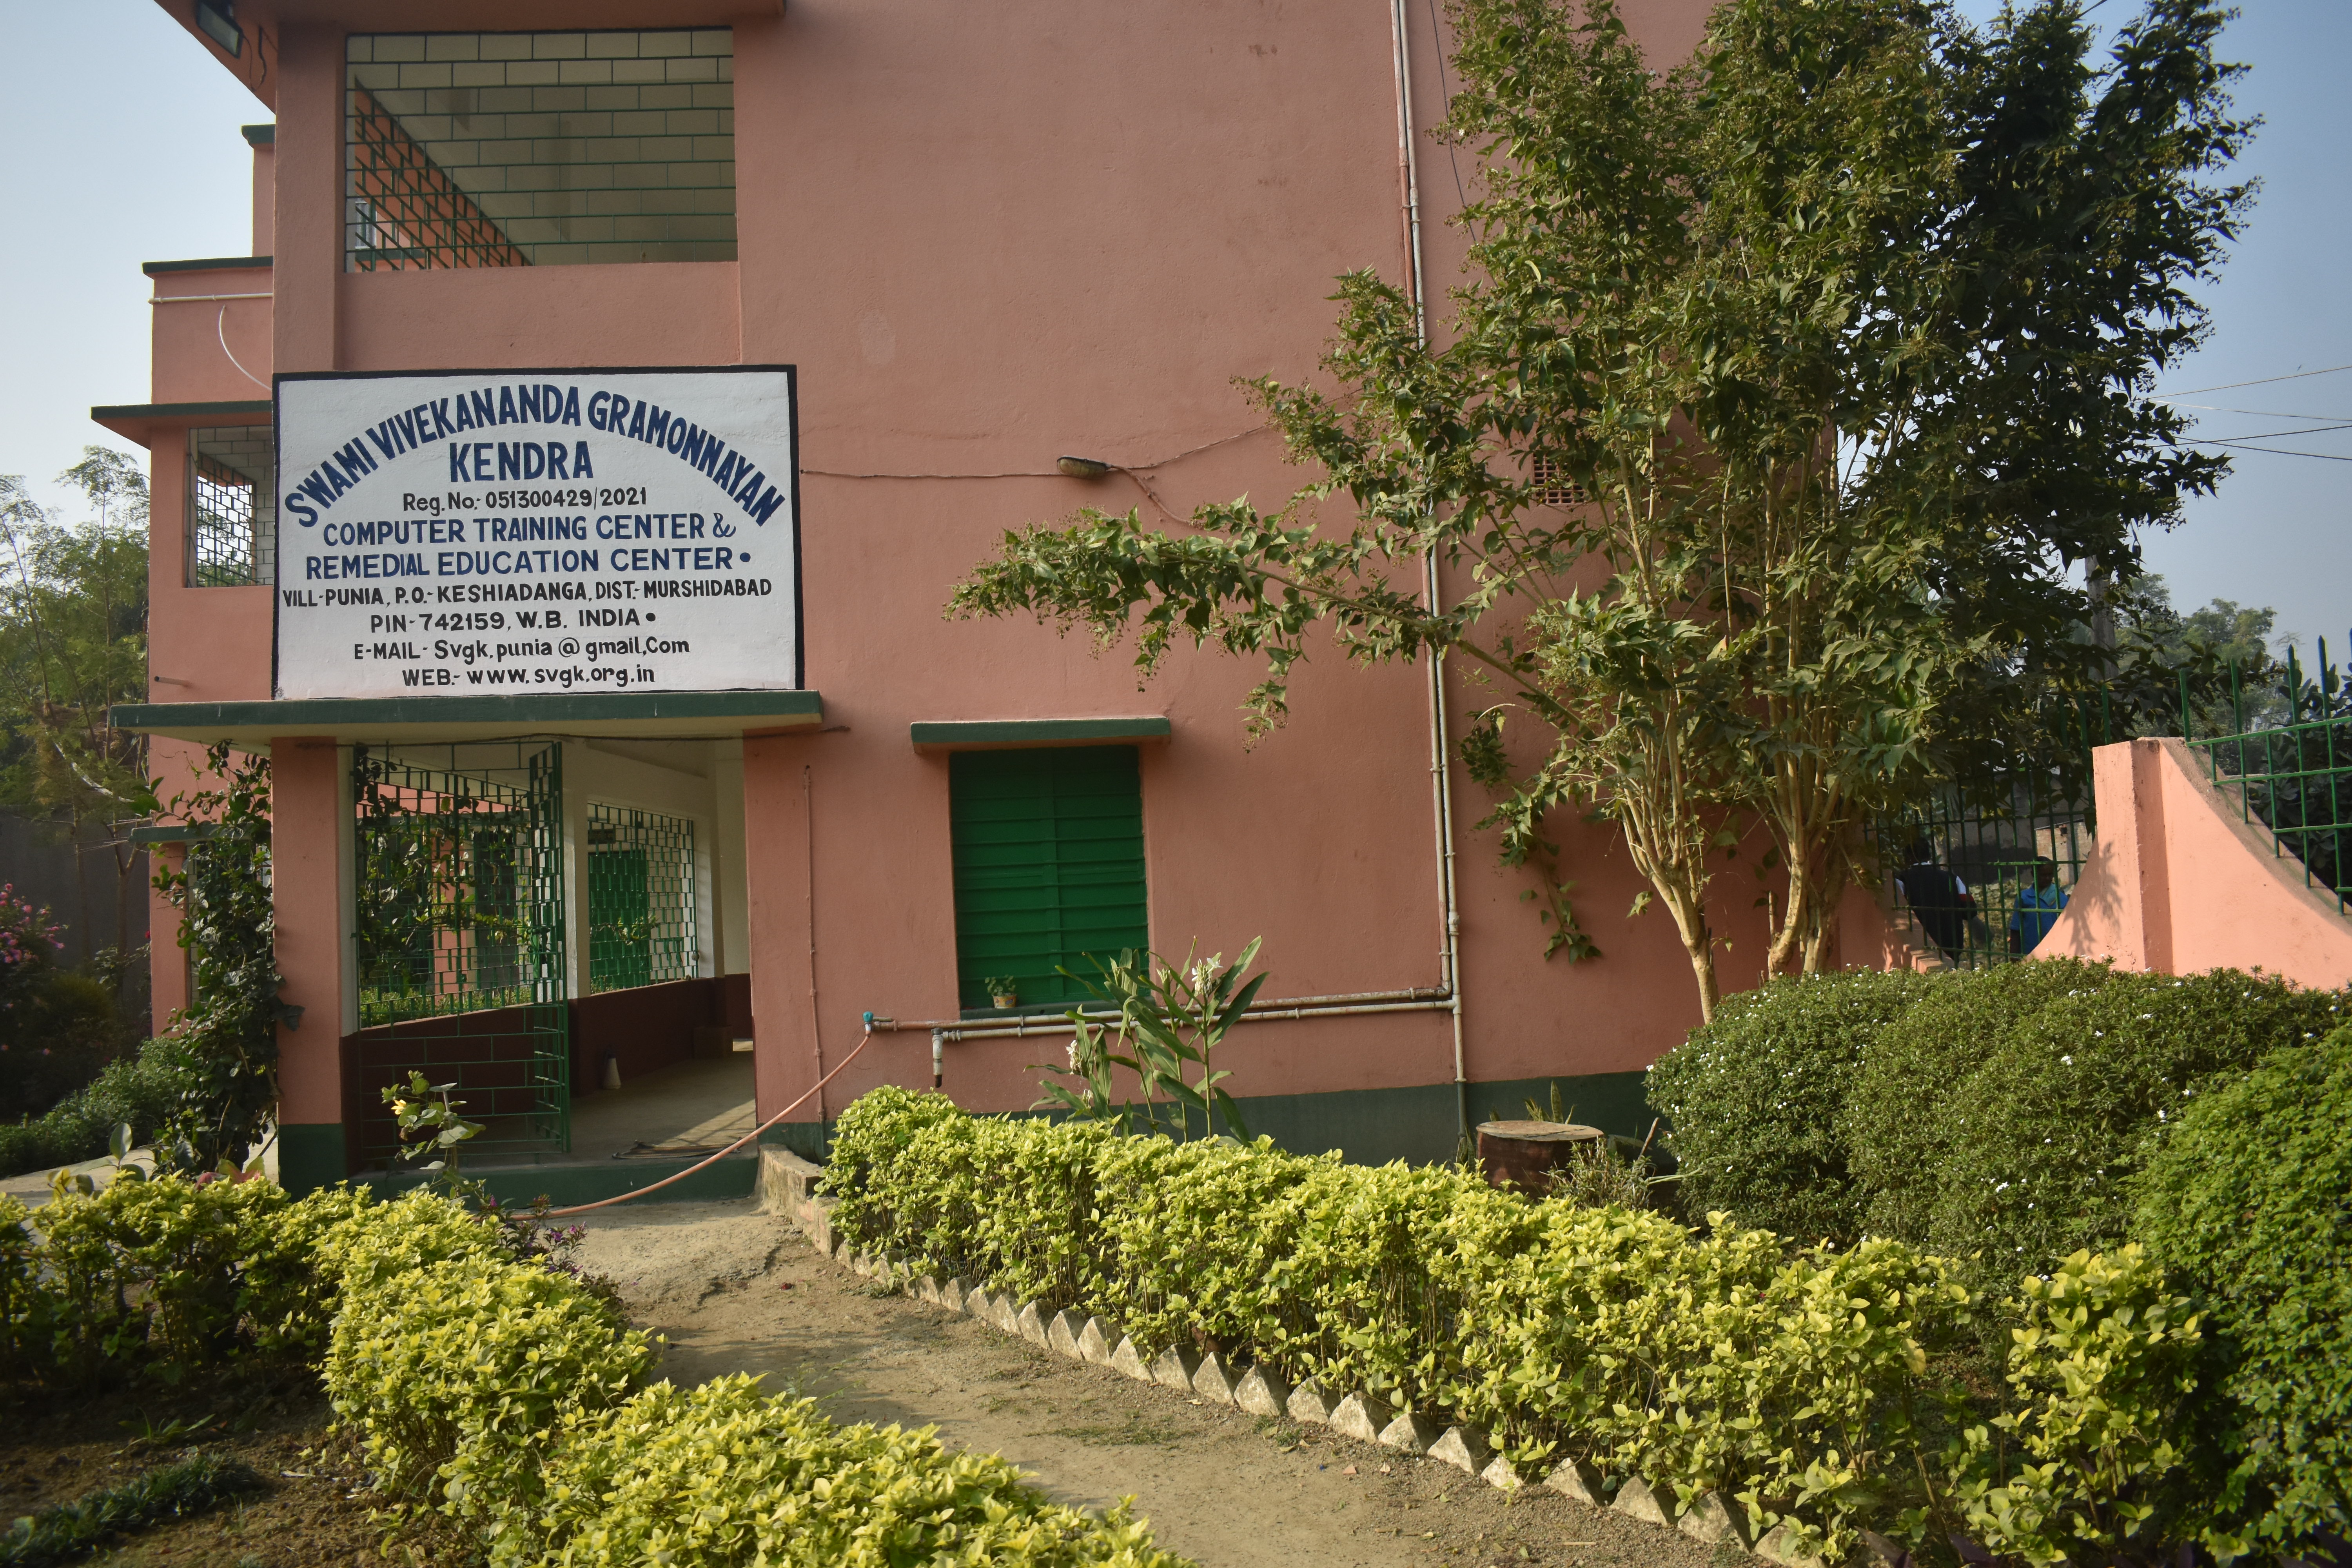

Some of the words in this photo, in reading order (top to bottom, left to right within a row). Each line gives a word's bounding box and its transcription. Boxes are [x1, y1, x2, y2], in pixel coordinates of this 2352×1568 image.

[284, 436, 379, 528] SWAMI
[365, 384, 581, 461] VIVEKANANDA
[587, 390, 786, 527] GRAMONNAYAN
[449, 441, 594, 483] KENDRA
[485, 486, 647, 510] 051300429/2021
[323, 518, 466, 546] COMPUTER
[473, 515, 587, 543] TRAINING
[595, 513, 705, 540] CENTER
[712, 512, 737, 538] &
[306, 552, 430, 580] REMEDIAL
[437, 549, 599, 576] EDUCATION
[610, 546, 733, 572] CENTER
[644, 578, 772, 599] MURSHIDABAD
[578, 608, 641, 627] INDIA
